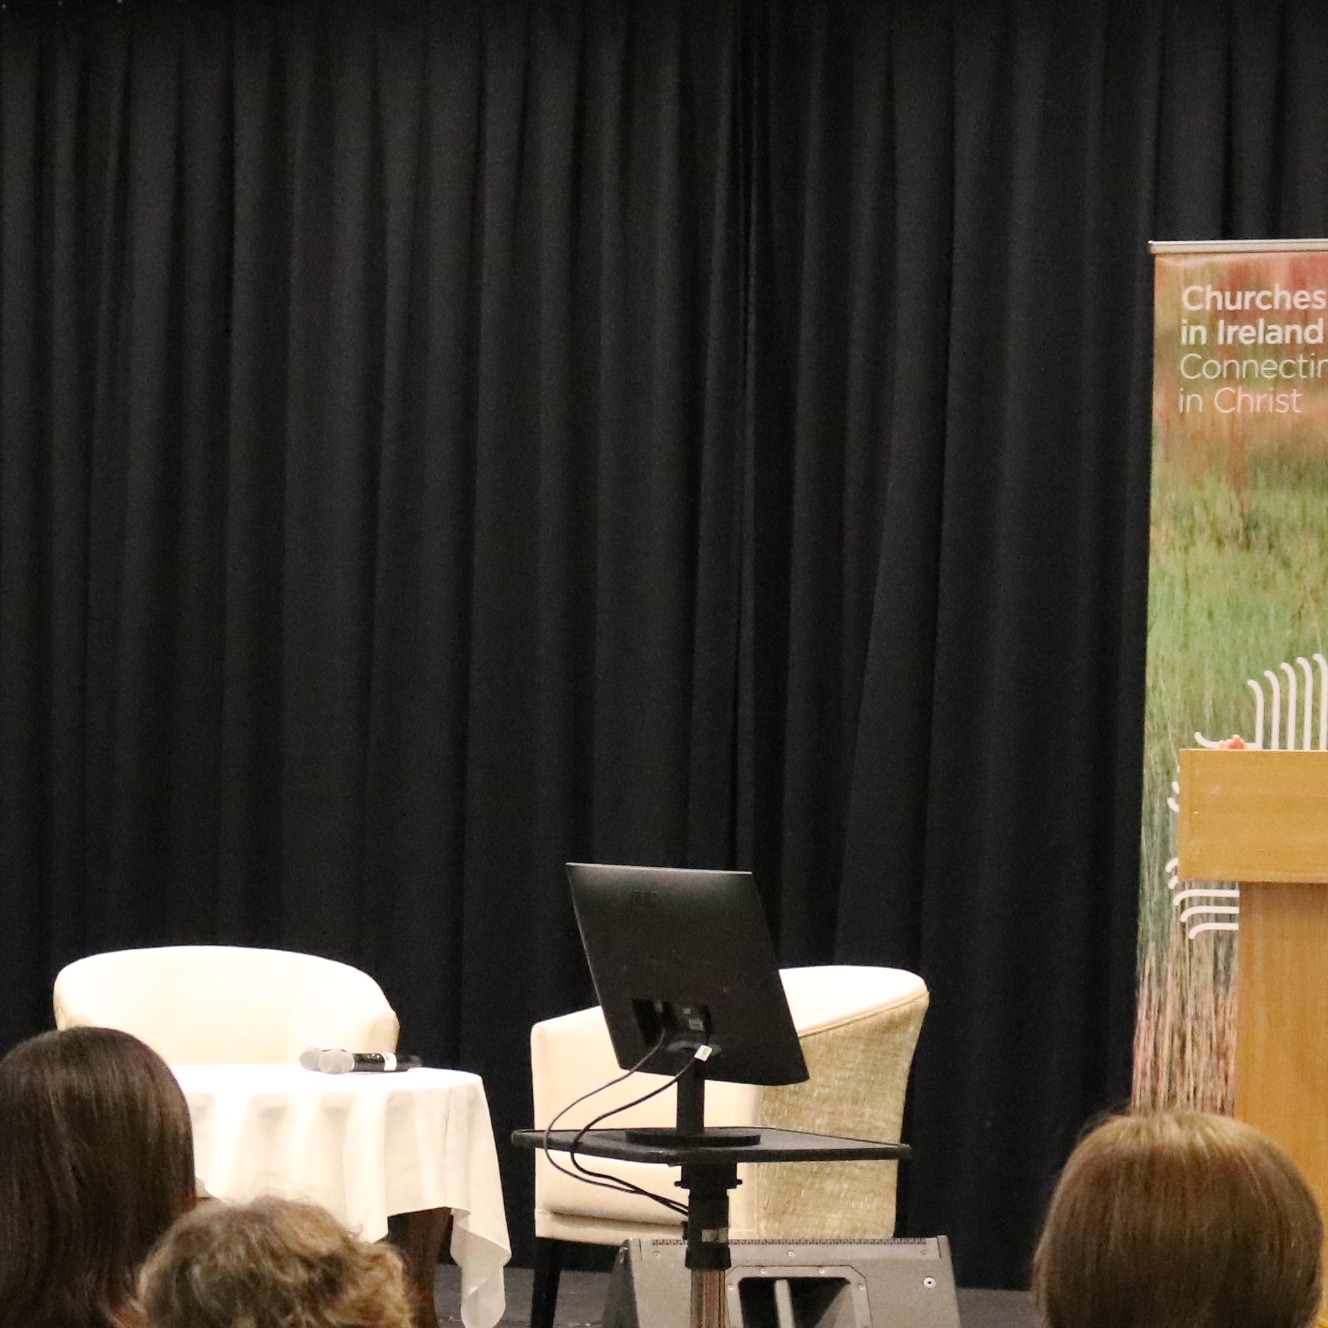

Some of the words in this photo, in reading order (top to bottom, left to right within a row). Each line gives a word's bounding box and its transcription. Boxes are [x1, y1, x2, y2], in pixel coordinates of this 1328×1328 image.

[1181, 284, 1327, 311] Churches
[1180, 319, 1207, 345] in
[1217, 318, 1325, 345] Ireland
[1178, 388, 1203, 414] in
[1213, 387, 1302, 414] Christ
